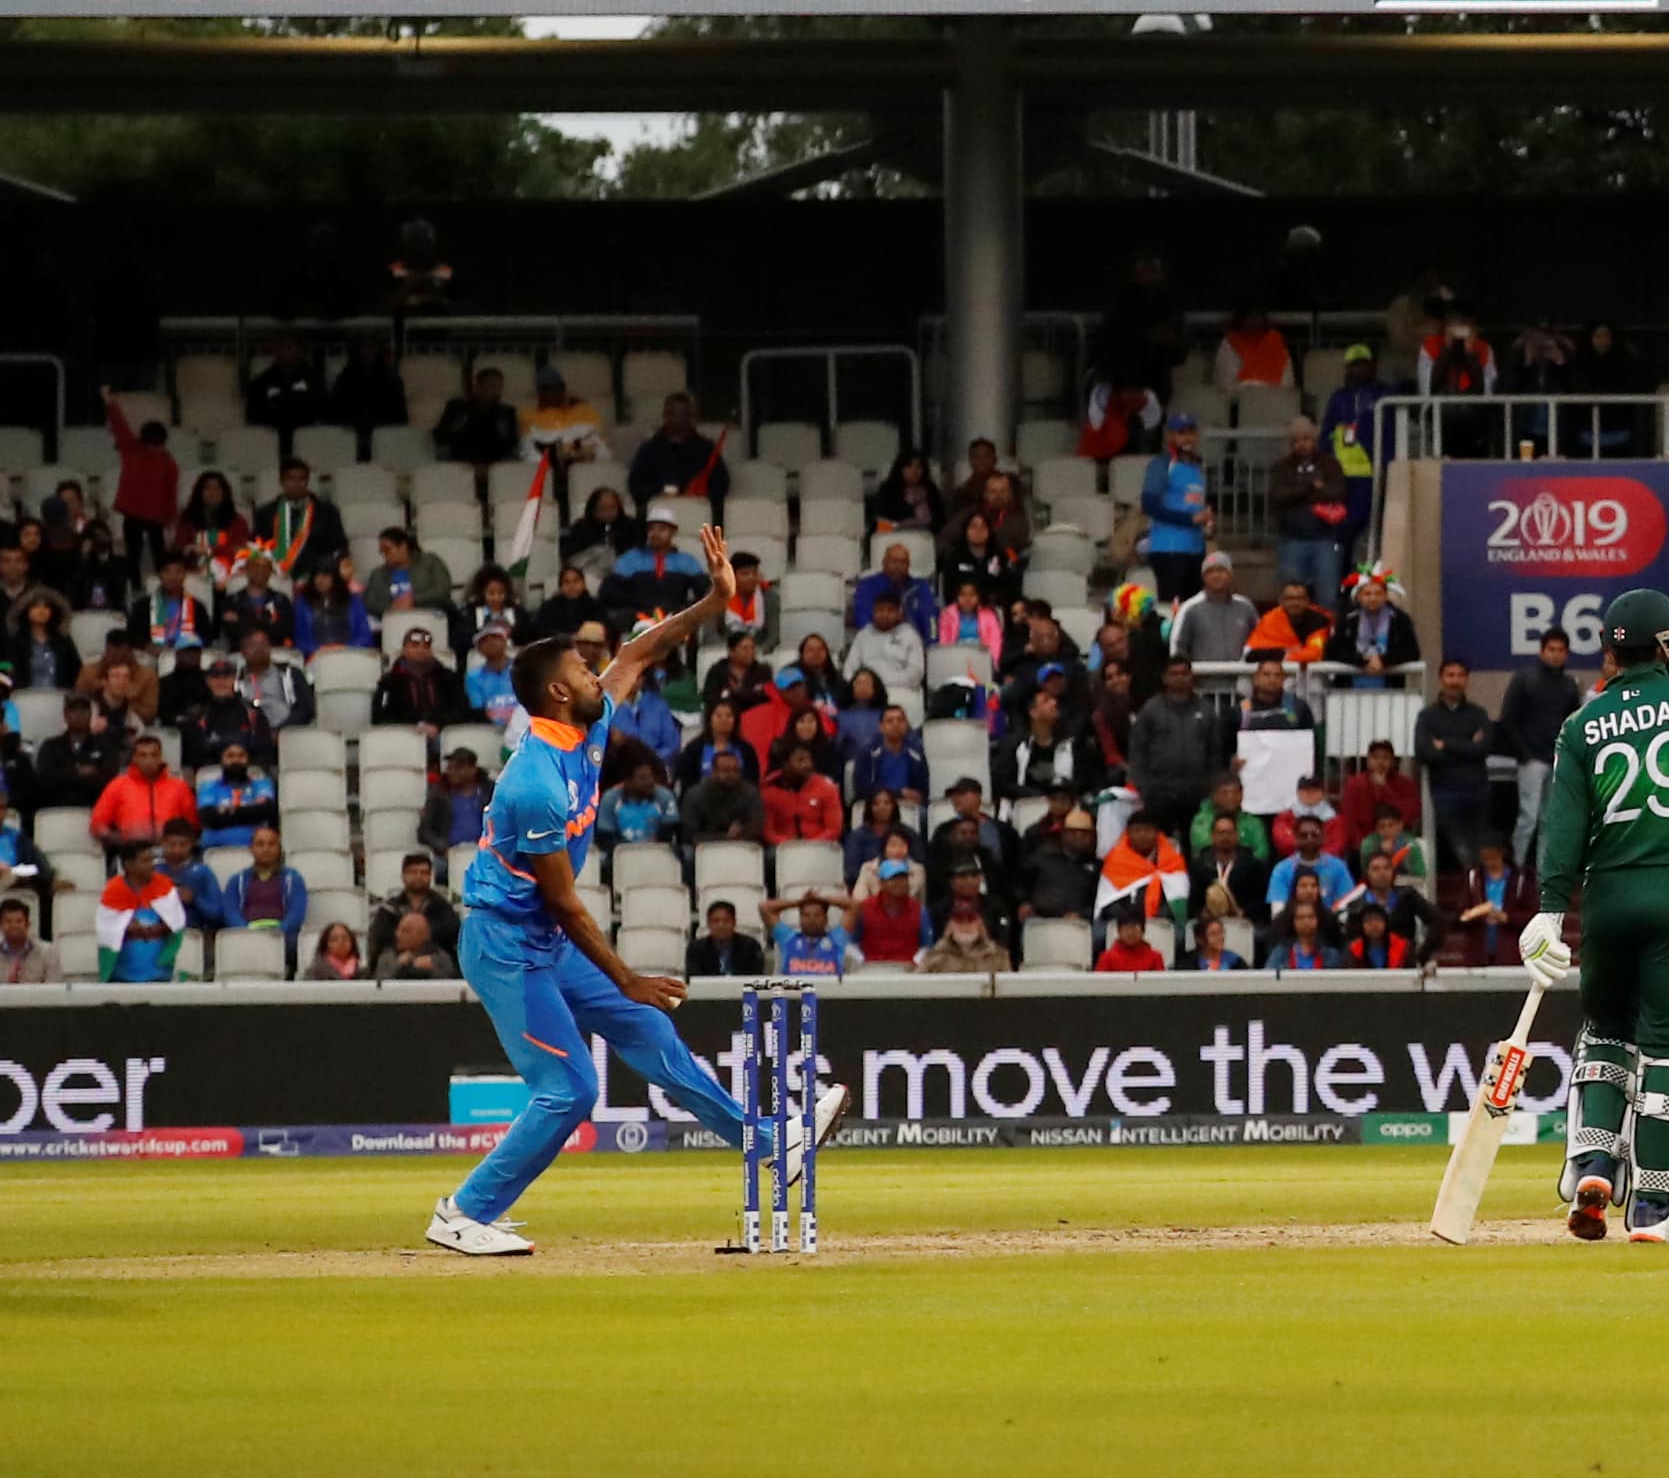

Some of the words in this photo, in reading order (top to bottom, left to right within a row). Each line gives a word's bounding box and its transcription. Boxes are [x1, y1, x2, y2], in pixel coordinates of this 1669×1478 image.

[1487, 547, 1559, 563] ENGLAND
[1576, 548, 1628, 561] WALES
[863, 1045, 1177, 1119] move
[1200, 1019, 1385, 1116] the
[897, 1123, 998, 1145] MOBILITY
[1030, 1127, 1102, 1145] NISSAN
[1110, 1118, 1238, 1145] INTELLIGENT
[1243, 1120, 1345, 1142] MOBILITY
[1379, 1122, 1433, 1138] oppo
[352, 1132, 435, 1151] Download
[438, 1133, 467, 1149] the
